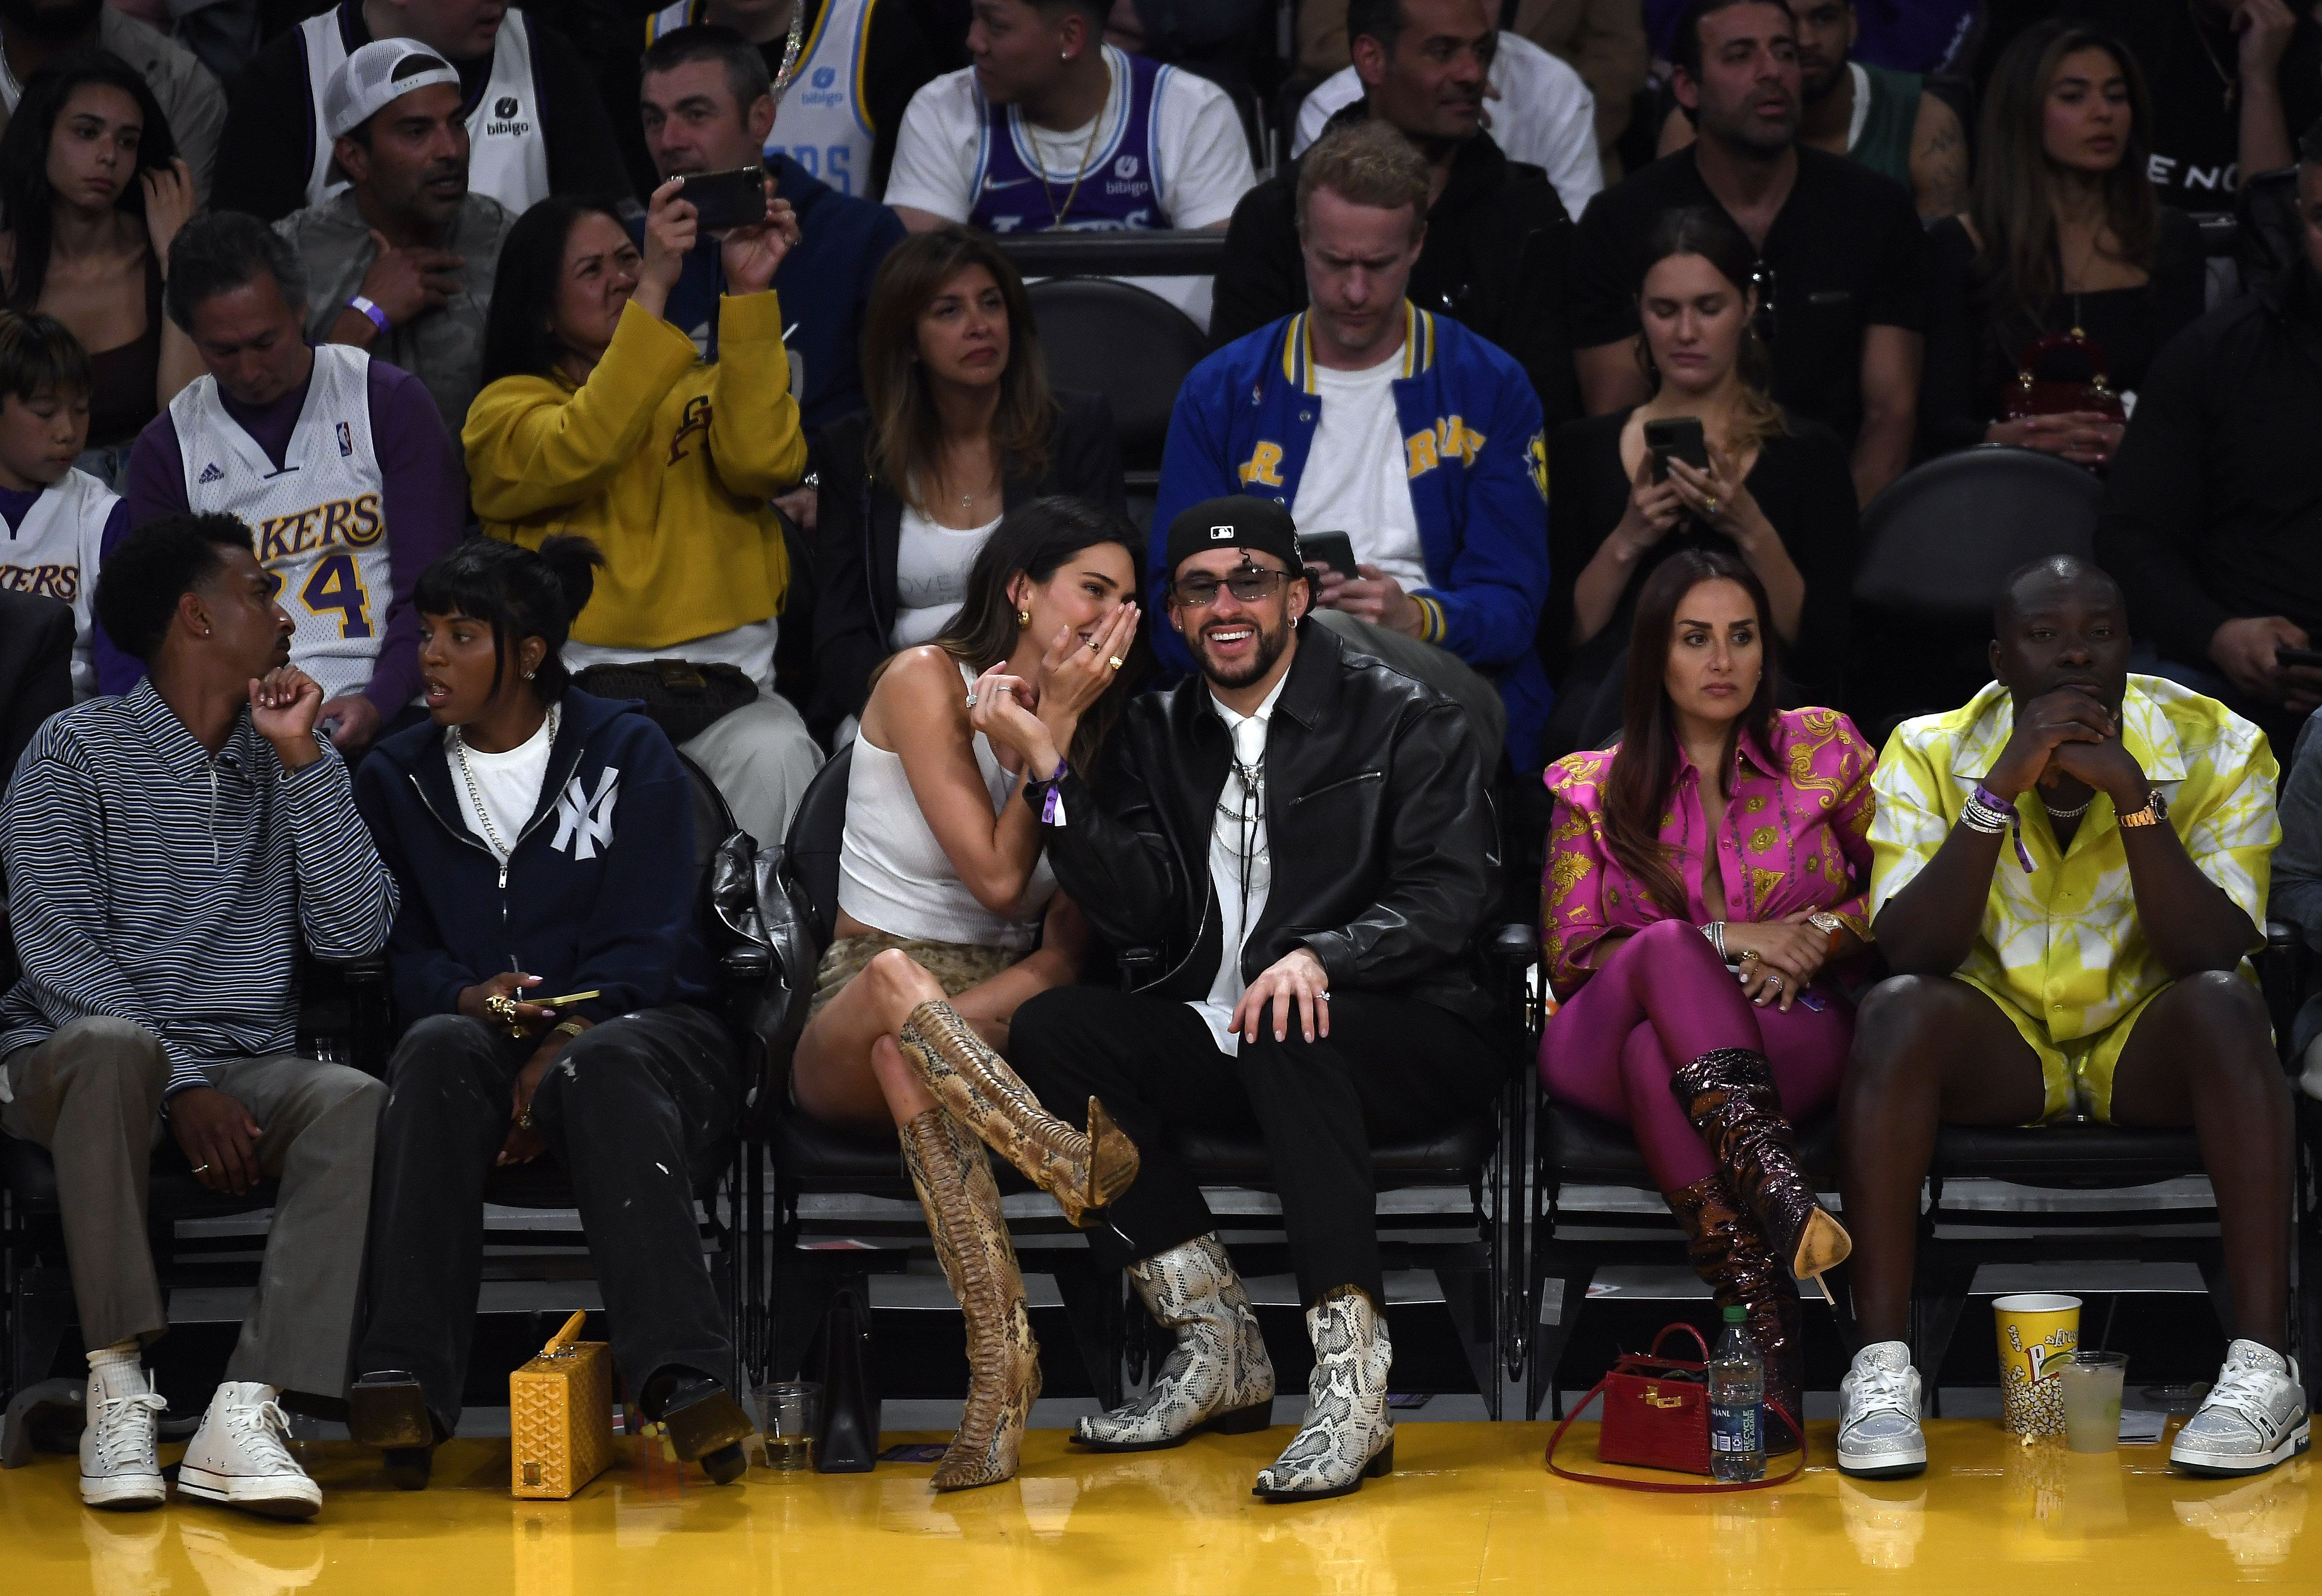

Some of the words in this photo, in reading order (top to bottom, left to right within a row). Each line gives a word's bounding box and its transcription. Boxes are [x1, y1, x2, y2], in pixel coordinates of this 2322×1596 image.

[487, 121, 529, 136] bibigo
[1106, 181, 1148, 198] bibigo
[199, 472, 224, 484] adidas
[251, 493, 384, 563] KERS
[550, 766, 619, 861] NY
[1749, 1437, 1755, 1451] ME
